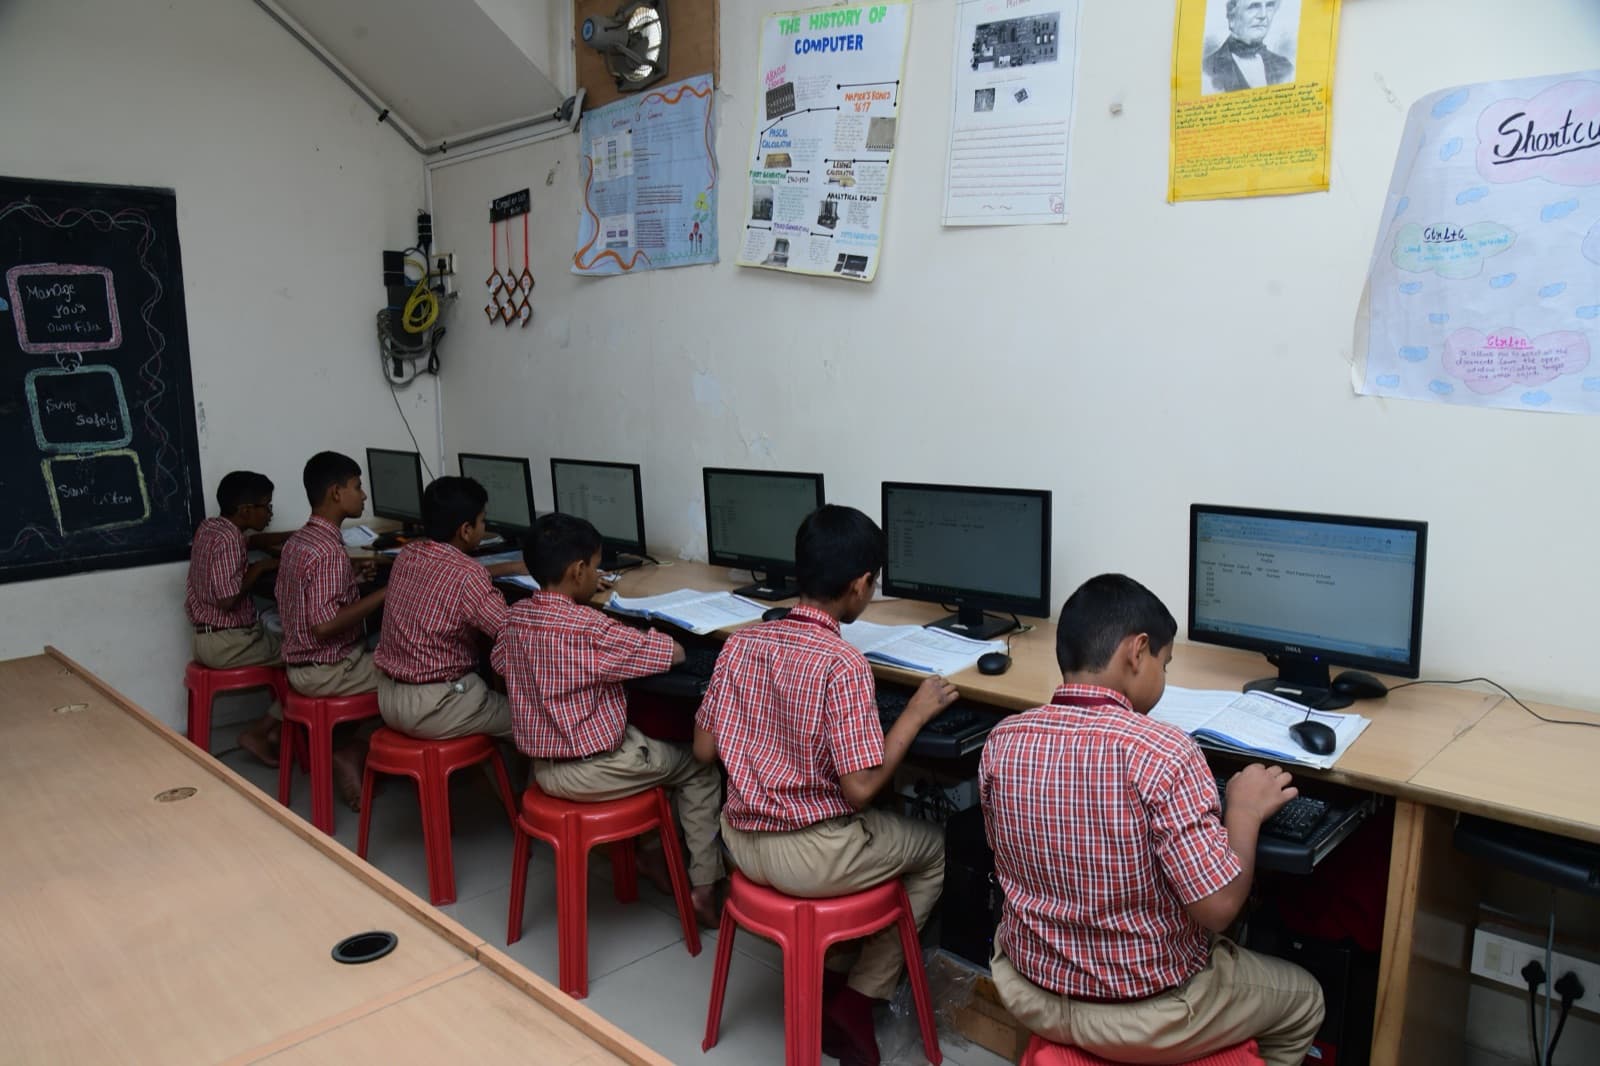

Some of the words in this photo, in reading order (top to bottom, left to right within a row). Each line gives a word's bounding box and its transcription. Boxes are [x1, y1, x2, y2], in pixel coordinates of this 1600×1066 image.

[778, 17, 801, 36] THE
[808, 8, 863, 30] HISTORY
[868, 6, 888, 24] OF
[794, 34, 864, 55] COMPUTER
